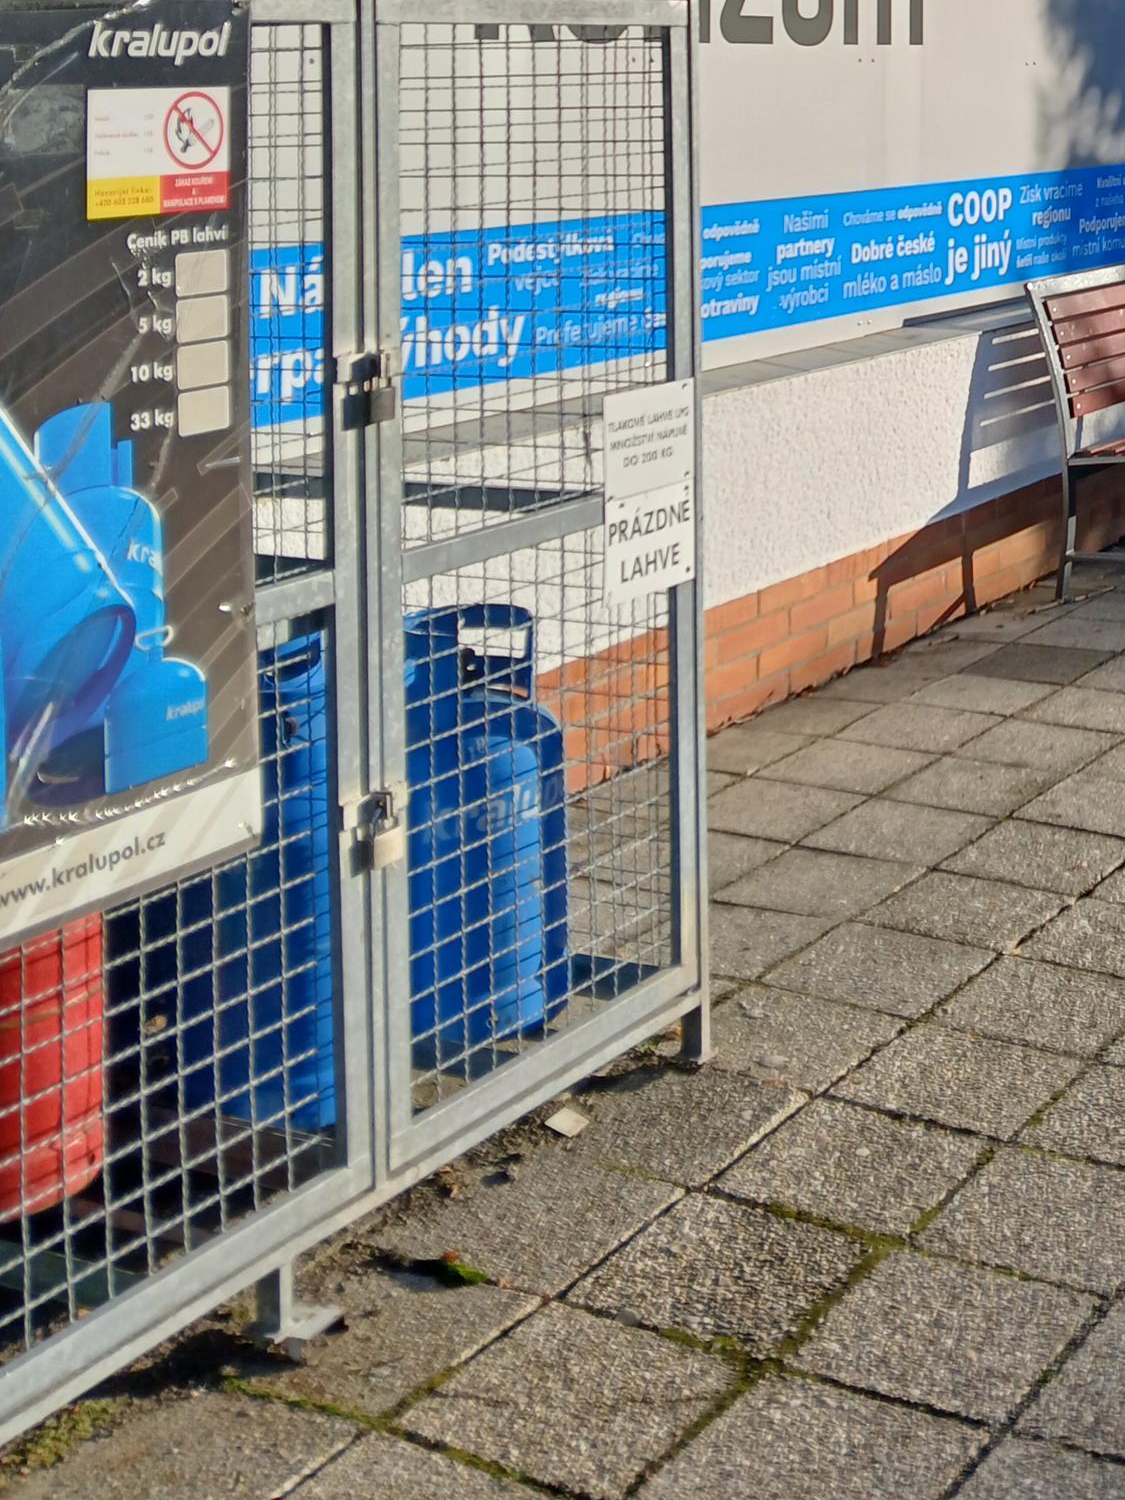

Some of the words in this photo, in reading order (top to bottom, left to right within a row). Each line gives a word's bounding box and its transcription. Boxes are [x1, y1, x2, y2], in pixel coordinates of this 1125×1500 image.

[88, 20, 232, 66] kralupol
[947, 187, 1012, 227] COOP
[1020, 184, 1042, 204] Zisk
[784, 209, 829, 234] Našimi
[1032, 206, 1071, 228] regionu
[171, 229, 189, 245] PB
[851, 236, 894, 264] Dobré
[896, 230, 935, 257] české
[777, 237, 835, 264] partnery
[945, 239, 968, 285] je
[971, 230, 1012, 280] jiný
[137, 269, 147, 287] 2
[152, 267, 172, 288] kg
[766, 264, 797, 291] jsou
[801, 255, 841, 280] místní
[843, 272, 887, 299] mléko
[890, 274, 899, 291] a
[902, 262, 942, 288] máslo
[780, 283, 829, 313] výrobci
[138, 317, 148, 334] 5
[152, 316, 173, 337] kg
[131, 365, 149, 382] 10
[154, 361, 173, 383] kg
[130, 413, 150, 431] 33
[155, 409, 173, 432] kg
[623, 455, 638, 468] DO
[660, 446, 673, 459] KG
[620, 542, 680, 584] LAHVE
